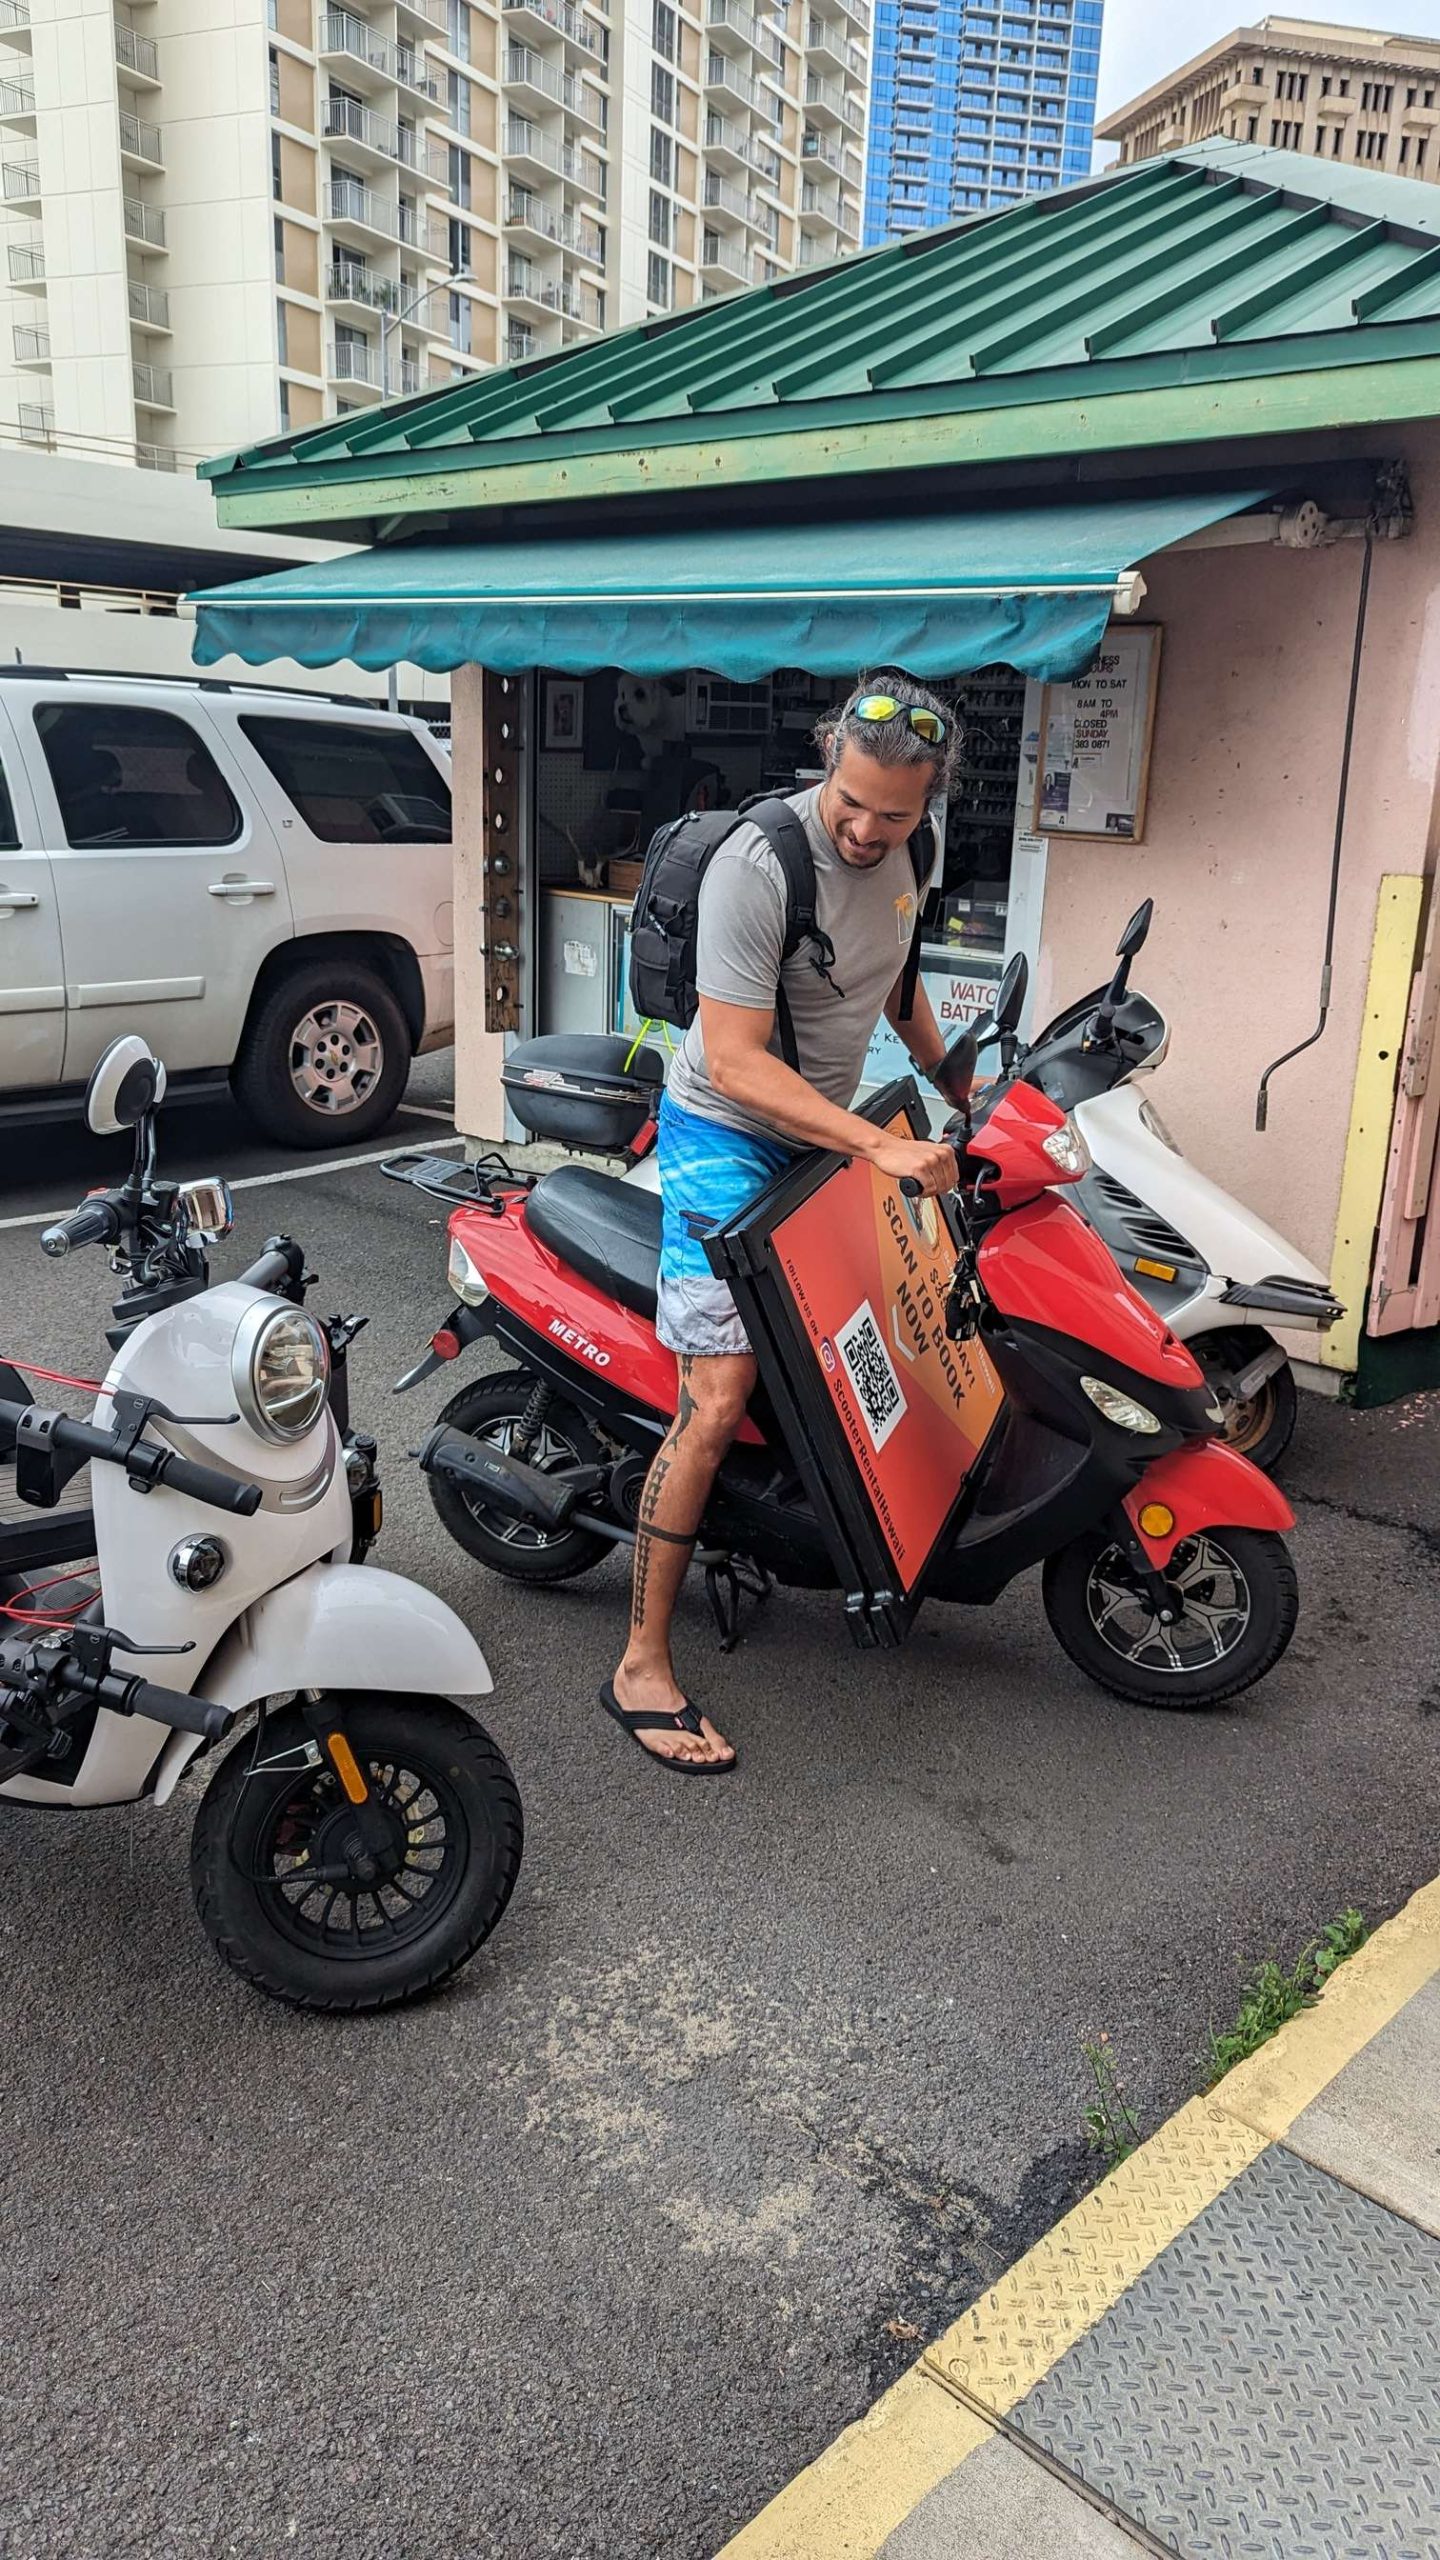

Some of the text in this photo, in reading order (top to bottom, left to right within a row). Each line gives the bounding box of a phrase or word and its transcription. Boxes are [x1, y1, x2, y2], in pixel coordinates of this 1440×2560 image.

[1091, 663, 1114, 674] OURS
[1071, 679, 1127, 689] MON TO SAT
[1076, 698, 1113, 709] 8AM TO
[1100, 709, 1119, 719] 4PM
[1074, 719, 1108, 729] CLOSED
[1076, 729, 1109, 739] SUNDAY
[951, 980, 998, 1005] WATC
[882, 1195, 966, 1410] SCAN TO BOOK
[803, 1302, 813, 1319] US
[809, 1320, 819, 1336] ON
[896, 1280, 931, 1355] NOW
[548, 1318, 611, 1367] METRO
[834, 1378, 906, 1562] ScooterRentalHawaii
